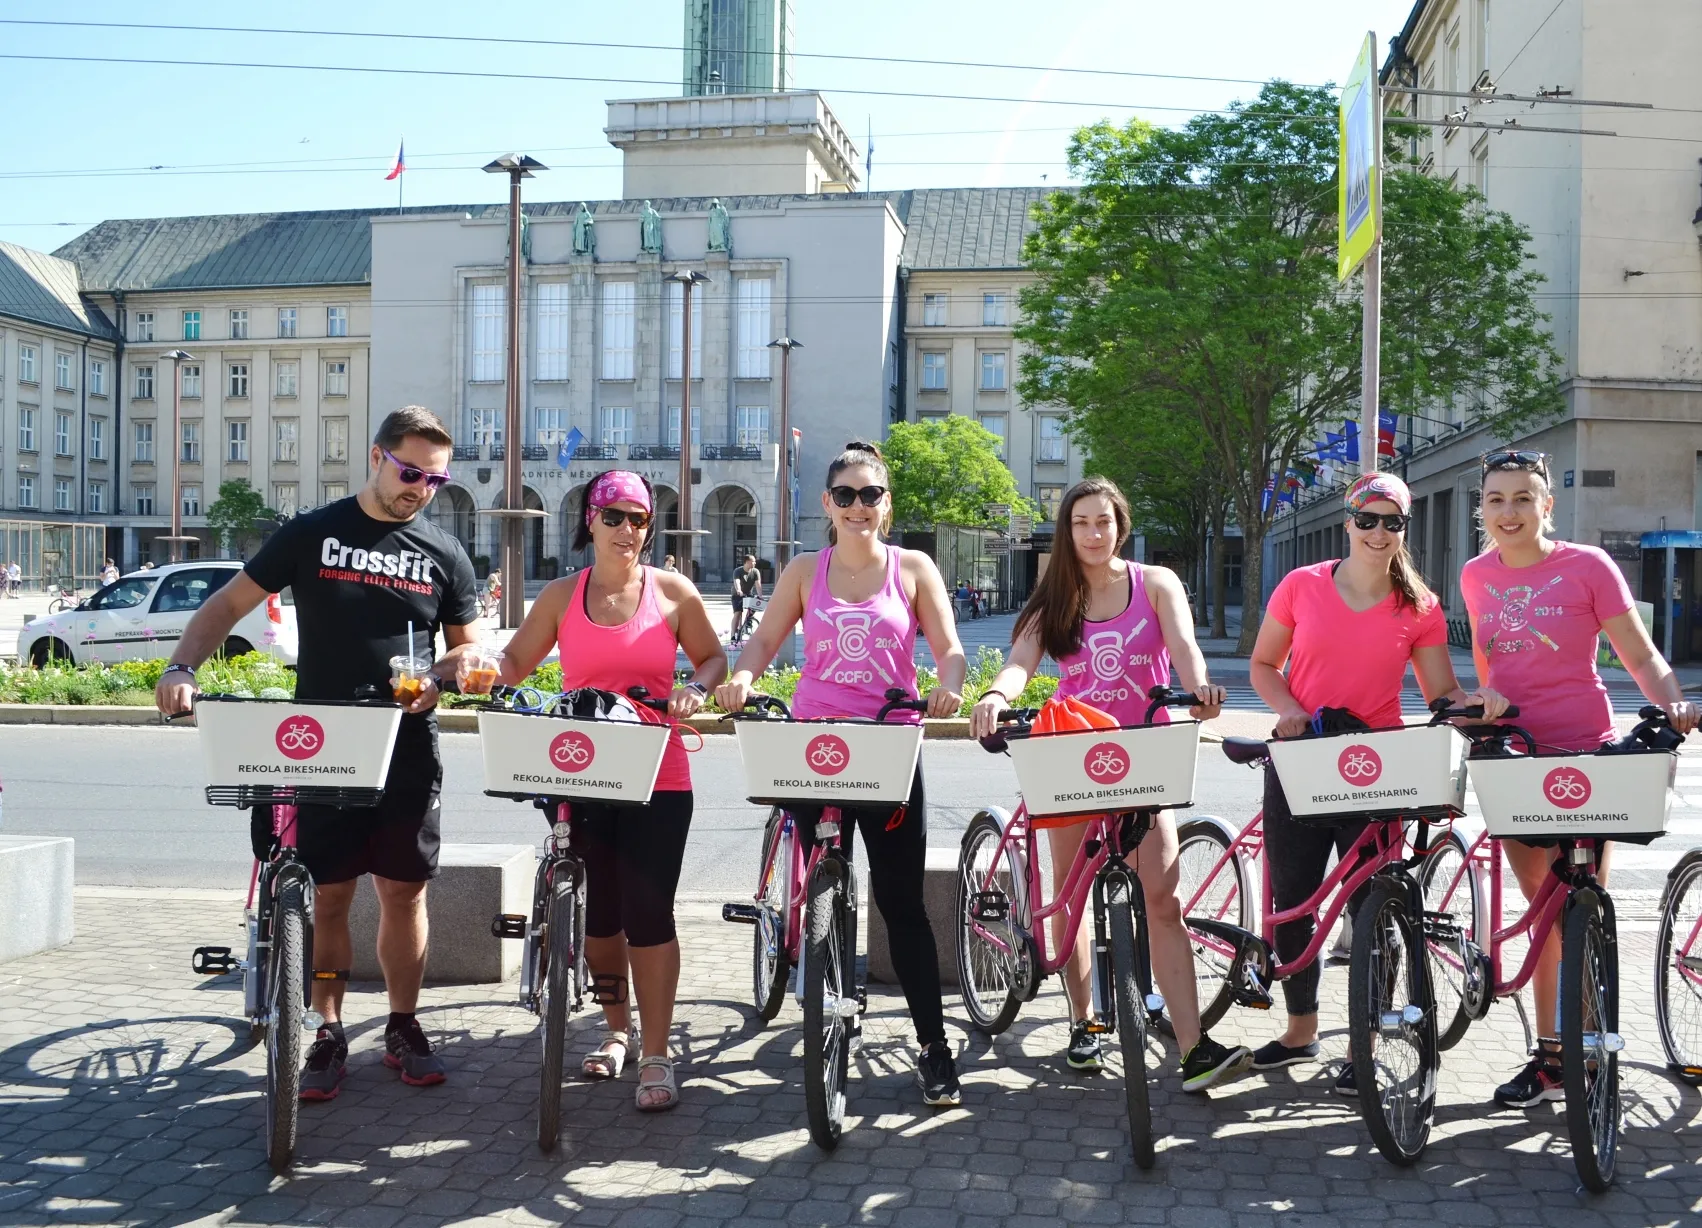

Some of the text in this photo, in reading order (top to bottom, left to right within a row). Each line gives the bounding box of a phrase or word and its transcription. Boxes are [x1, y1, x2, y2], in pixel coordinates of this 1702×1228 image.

[321, 537, 436, 583] CrossFit
[319, 568, 433, 595] FORGING ELITE FITNESS
[1534, 606, 1563, 616] 2014
[875, 637, 898, 650] 2014
[1067, 654, 1153, 676] EST 2014
[834, 670, 873, 684] CCFO
[1090, 687, 1129, 702] CCFO
[238, 764, 356, 774] REKOLA BIKESHARING
[512, 773, 623, 790] REKOLA BIKESHARING
[773, 779, 880, 789] REKOLA BIKESHARING
[1054, 791, 1094, 802] REKOLA
[1096, 785, 1165, 798] BIKESHARING
[1311, 787, 1418, 803] REKOLA BIKESHARING
[1512, 813, 1629, 823] REKOLA BIKESHARING
